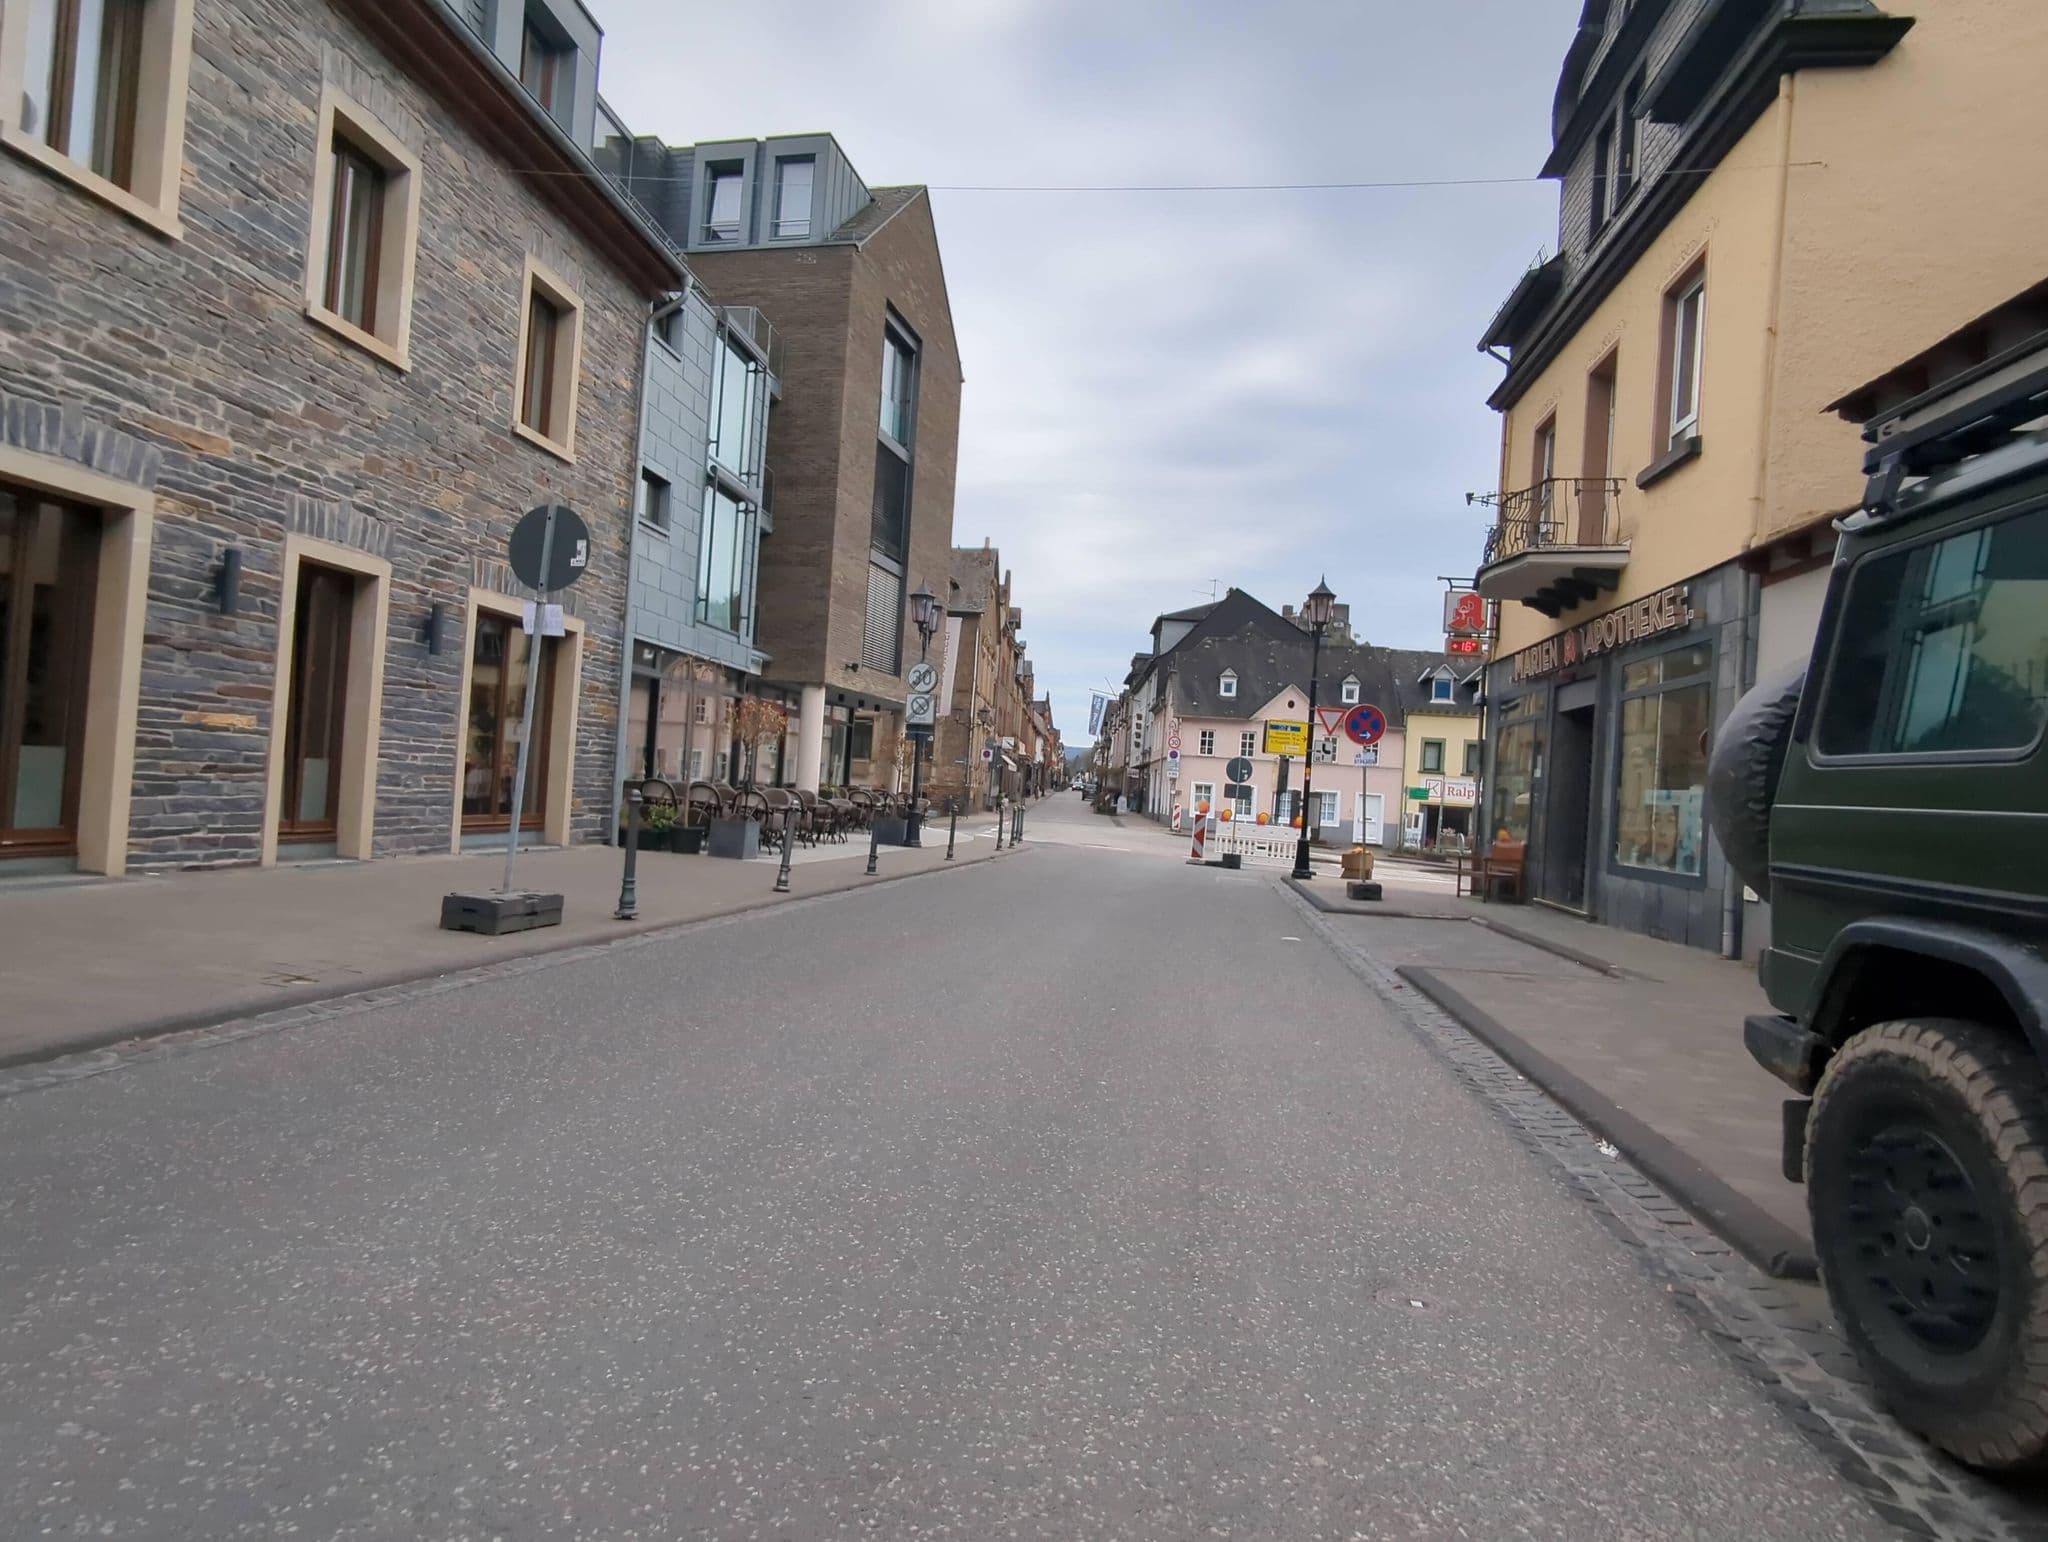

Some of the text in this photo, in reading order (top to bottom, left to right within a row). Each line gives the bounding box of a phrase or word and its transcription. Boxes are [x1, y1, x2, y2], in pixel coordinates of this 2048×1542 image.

[1514, 638, 1559, 681] MARIEN
[1582, 587, 1676, 657] APOTHEKE
[911, 669, 932, 686] 30
[1447, 786, 1475, 799] Ralp
